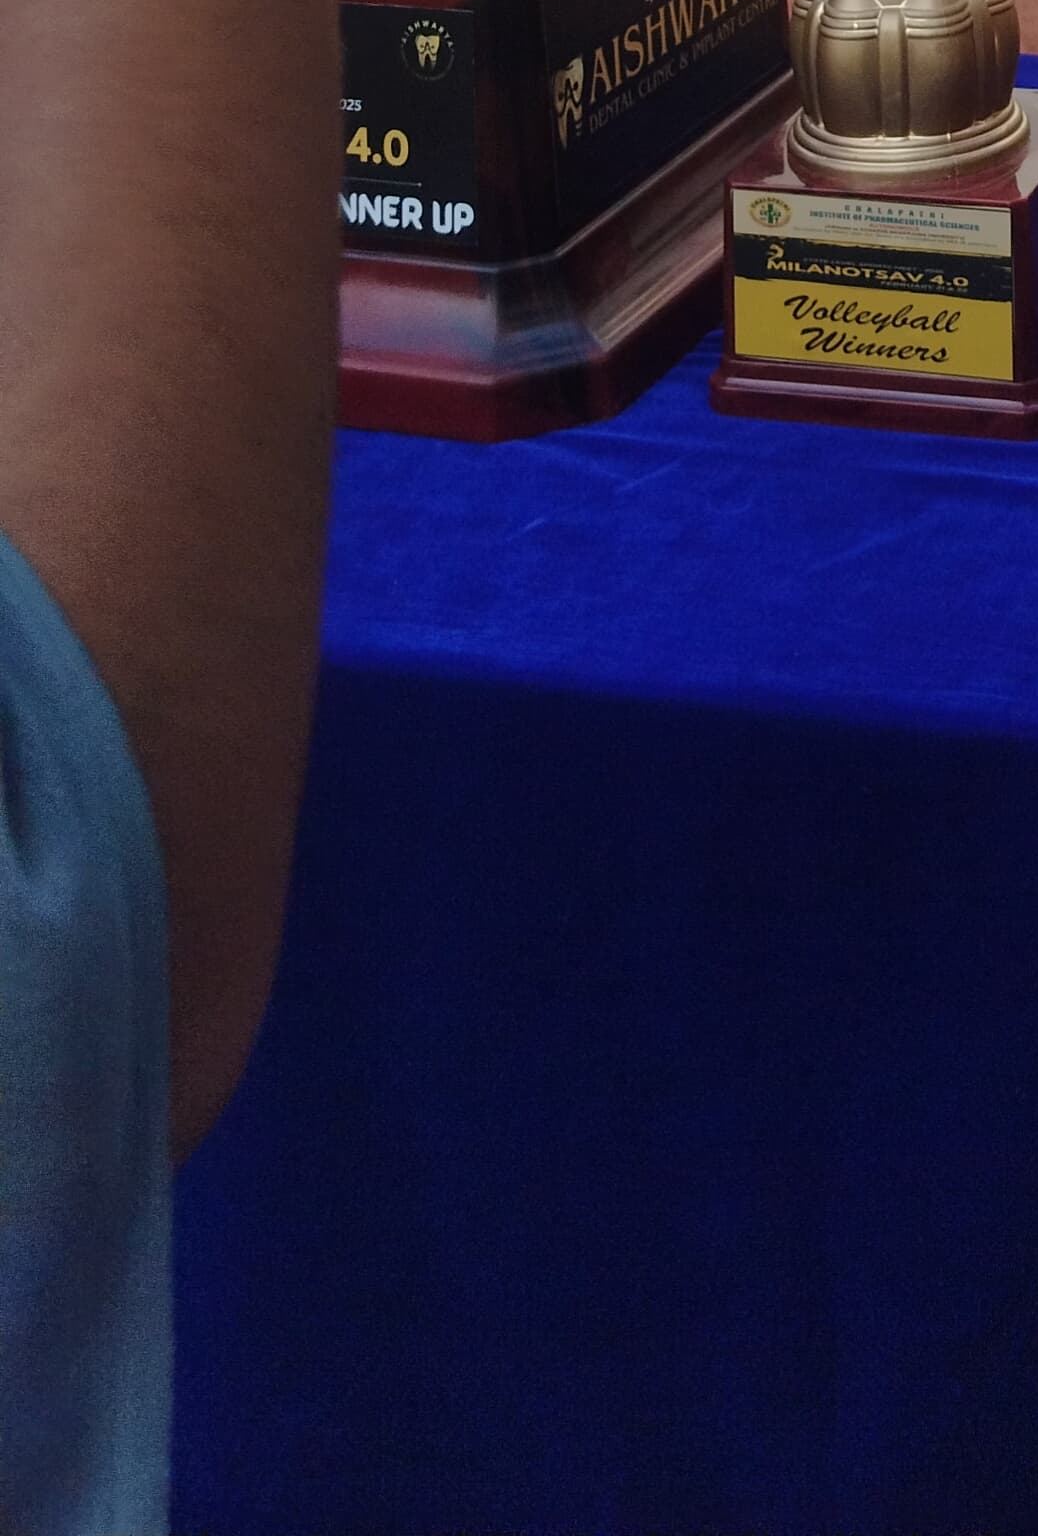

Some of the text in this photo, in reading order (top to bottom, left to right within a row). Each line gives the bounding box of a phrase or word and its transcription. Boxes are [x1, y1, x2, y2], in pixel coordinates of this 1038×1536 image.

[588, 89, 634, 134] DENTAL
[638, 58, 675, 98] CLINIC
[679, 51, 689, 70] &
[346, 127, 409, 166] 4.0
[432, 200, 475, 235] UP
[767, 260, 923, 283] MILANOTSAV
[930, 274, 969, 287] 4.0
[784, 294, 962, 333] Volleyball
[800, 327, 950, 364] Winners
